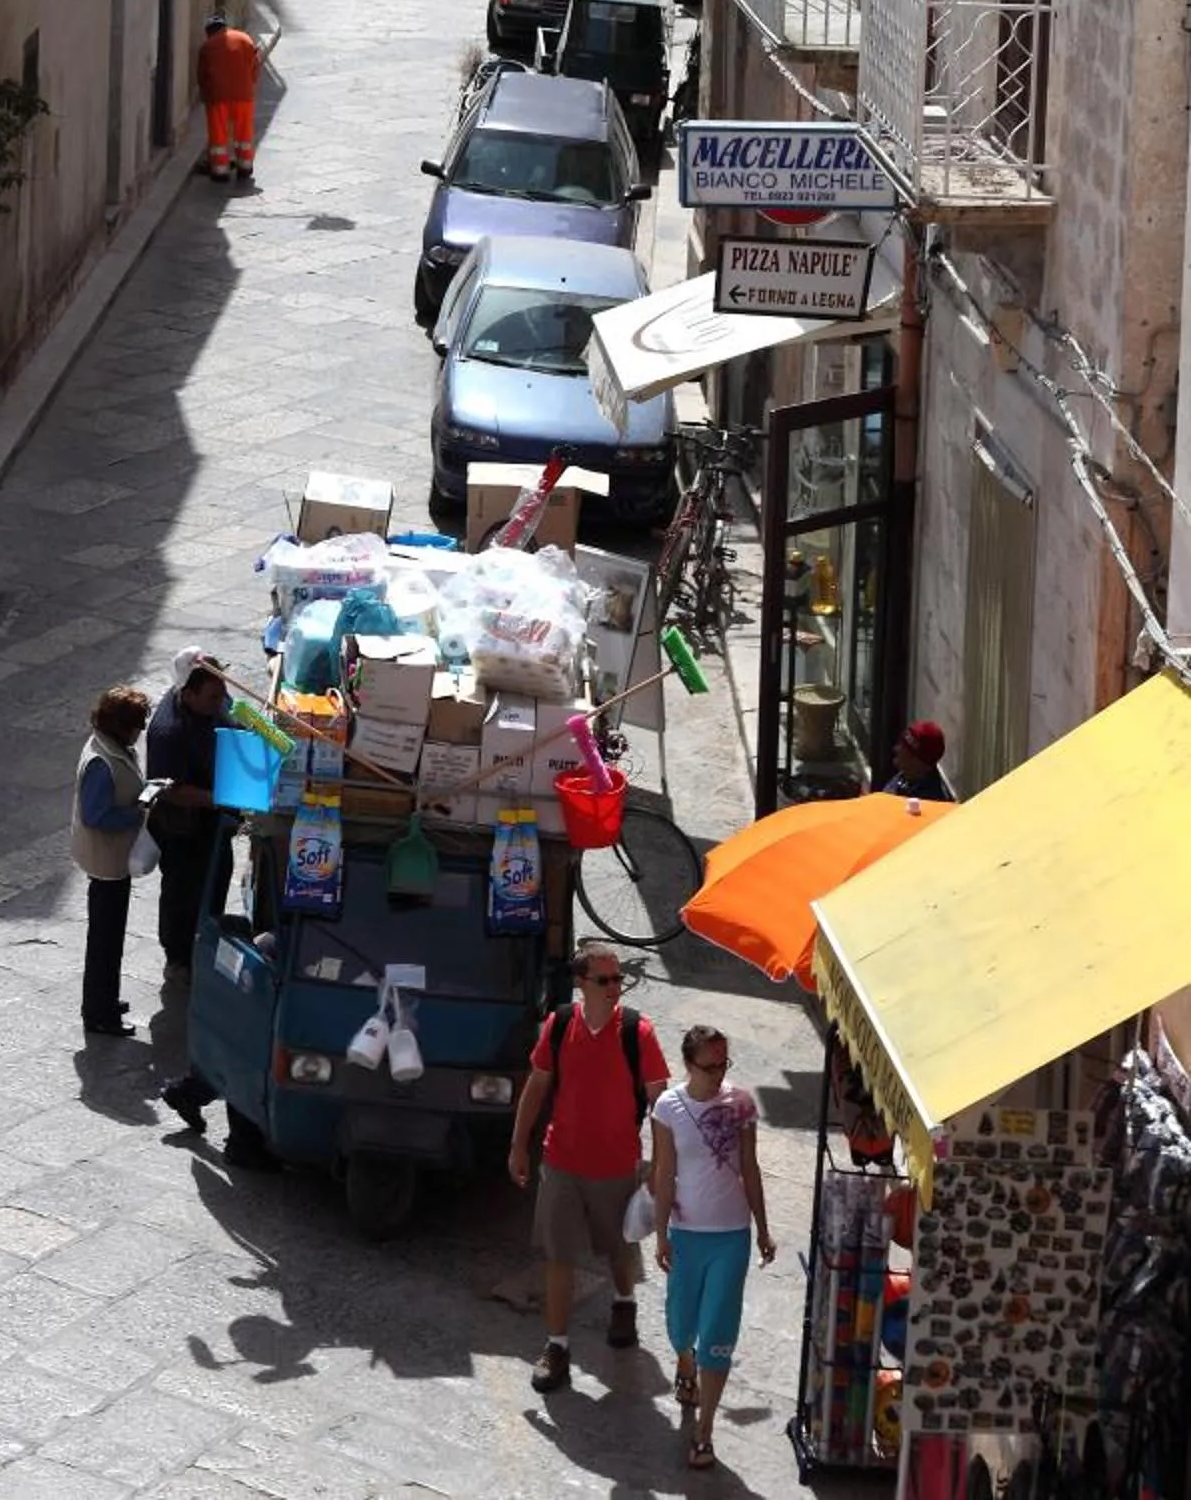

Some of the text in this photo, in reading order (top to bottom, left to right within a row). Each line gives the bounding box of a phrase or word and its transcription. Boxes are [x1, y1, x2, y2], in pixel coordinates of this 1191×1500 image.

[691, 136, 879, 170] MACELLERI
[696, 171, 885, 191] BIANCO MICHELE
[731, 247, 780, 273] PIZZA
[748, 287, 798, 305] FORNO
[811, 291, 857, 309] LEGNA
